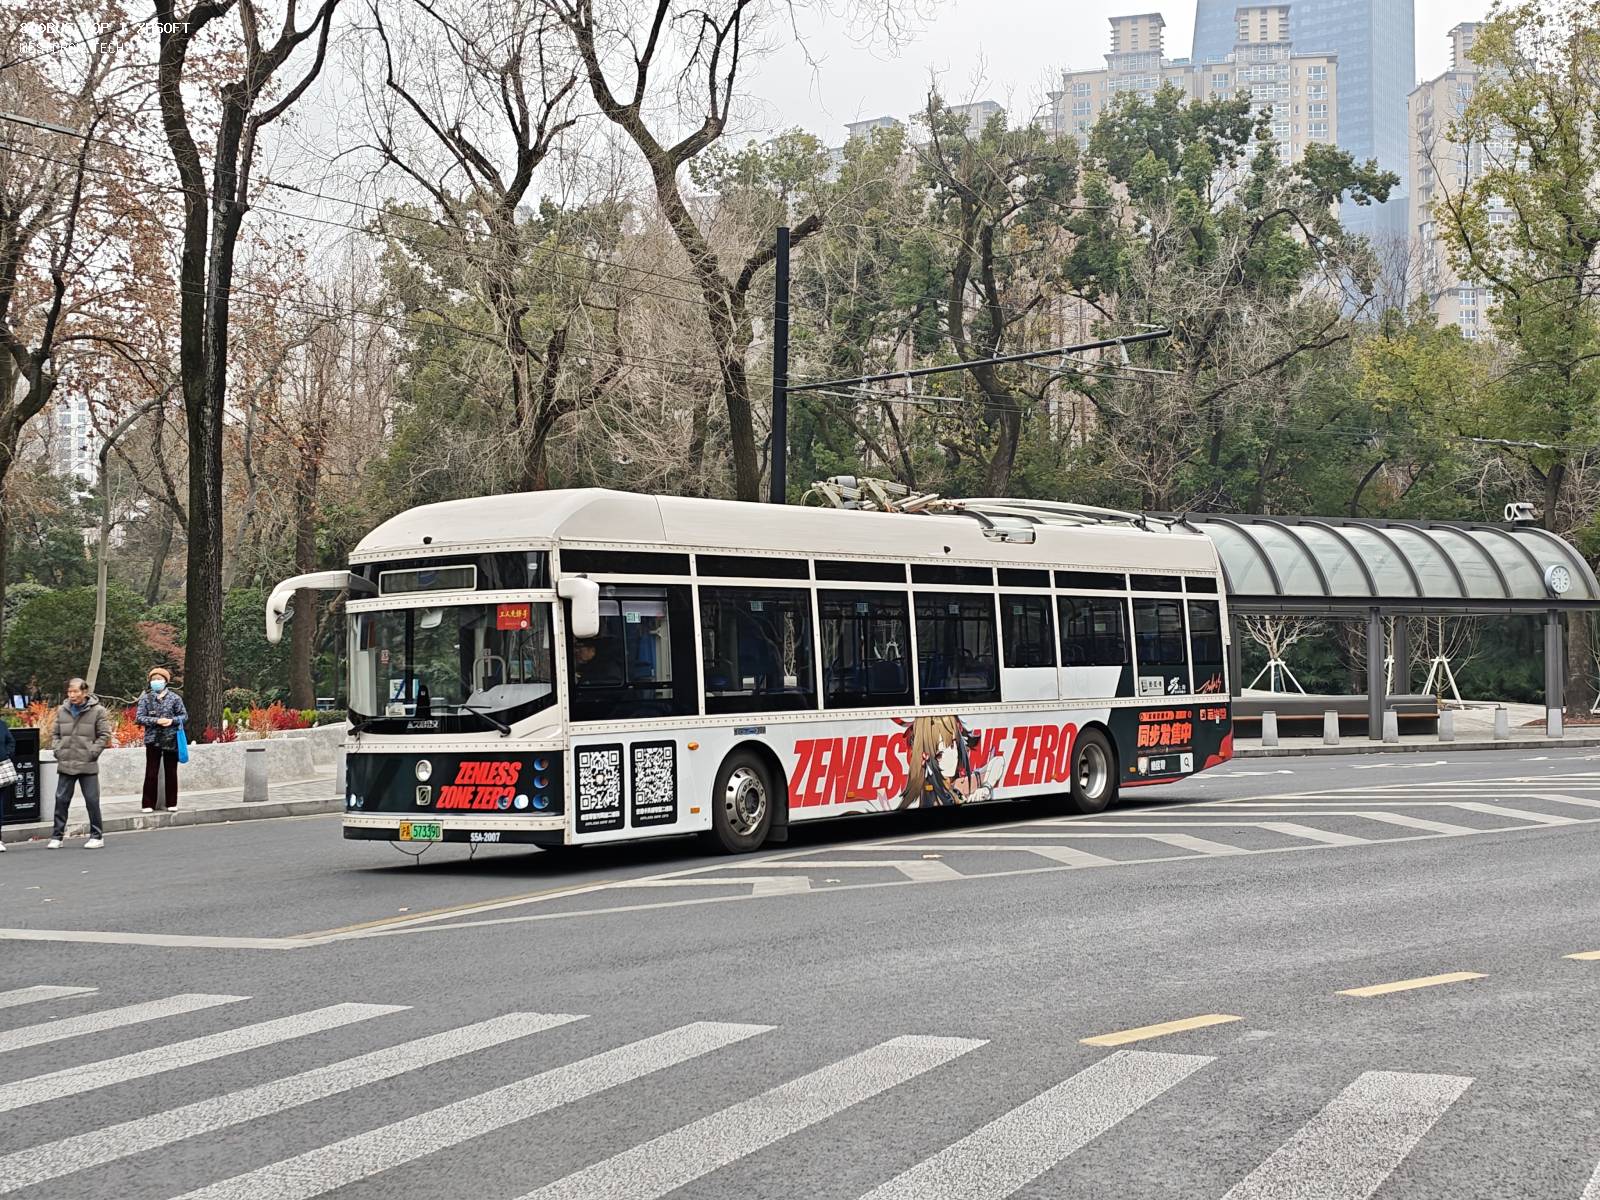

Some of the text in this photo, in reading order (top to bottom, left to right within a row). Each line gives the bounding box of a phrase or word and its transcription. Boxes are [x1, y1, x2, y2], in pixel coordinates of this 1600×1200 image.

[1137, 722, 1192, 748] 同步发售中
[454, 762, 523, 785] ZENLESS
[789, 732, 911, 809] ZENLES
[1003, 723, 1078, 787] ZERO
[436, 786, 516, 809] ZONE ZERO
